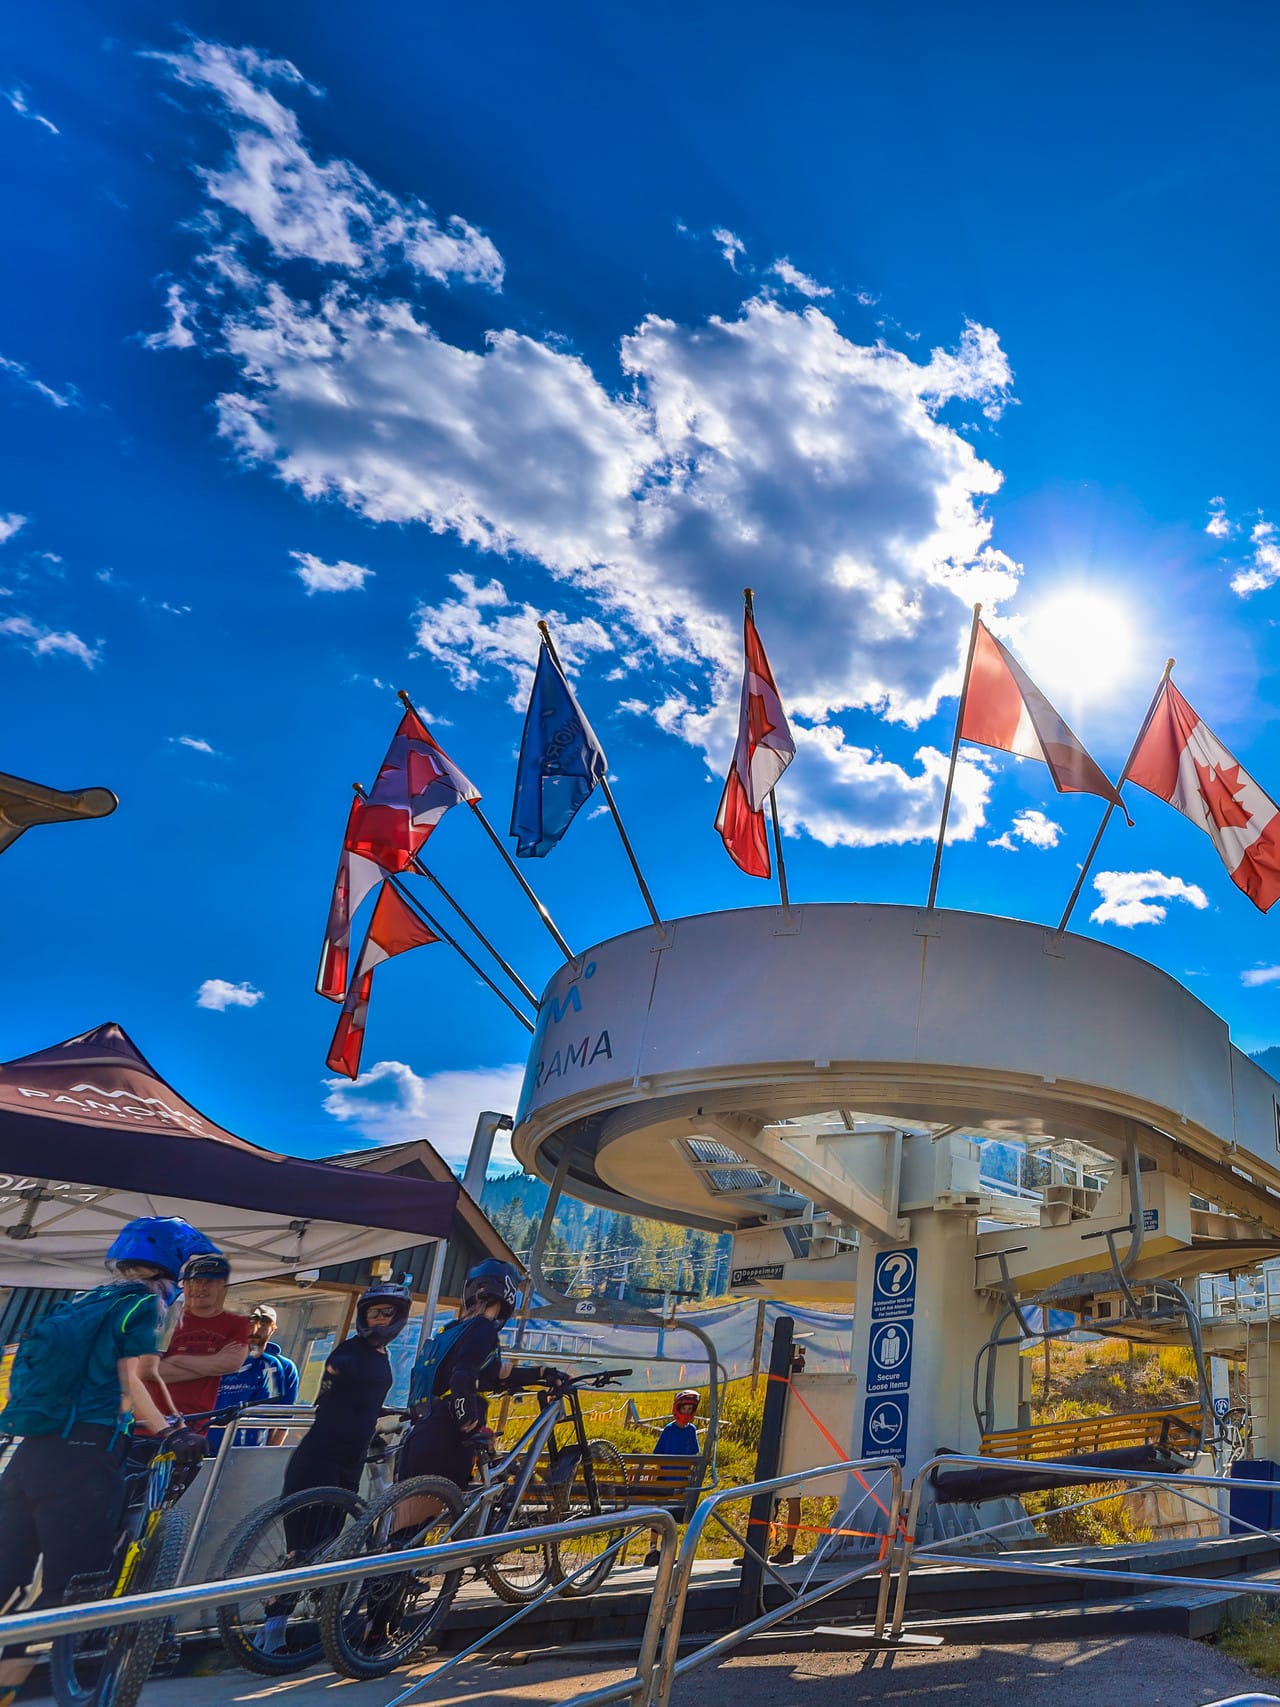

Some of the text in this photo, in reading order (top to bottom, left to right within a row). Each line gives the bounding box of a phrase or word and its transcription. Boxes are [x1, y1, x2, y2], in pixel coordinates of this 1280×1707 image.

[580, 1302, 593, 1311] 26
[877, 1373, 900, 1381] Secure
[868, 1381, 908, 1391] Loose Items
